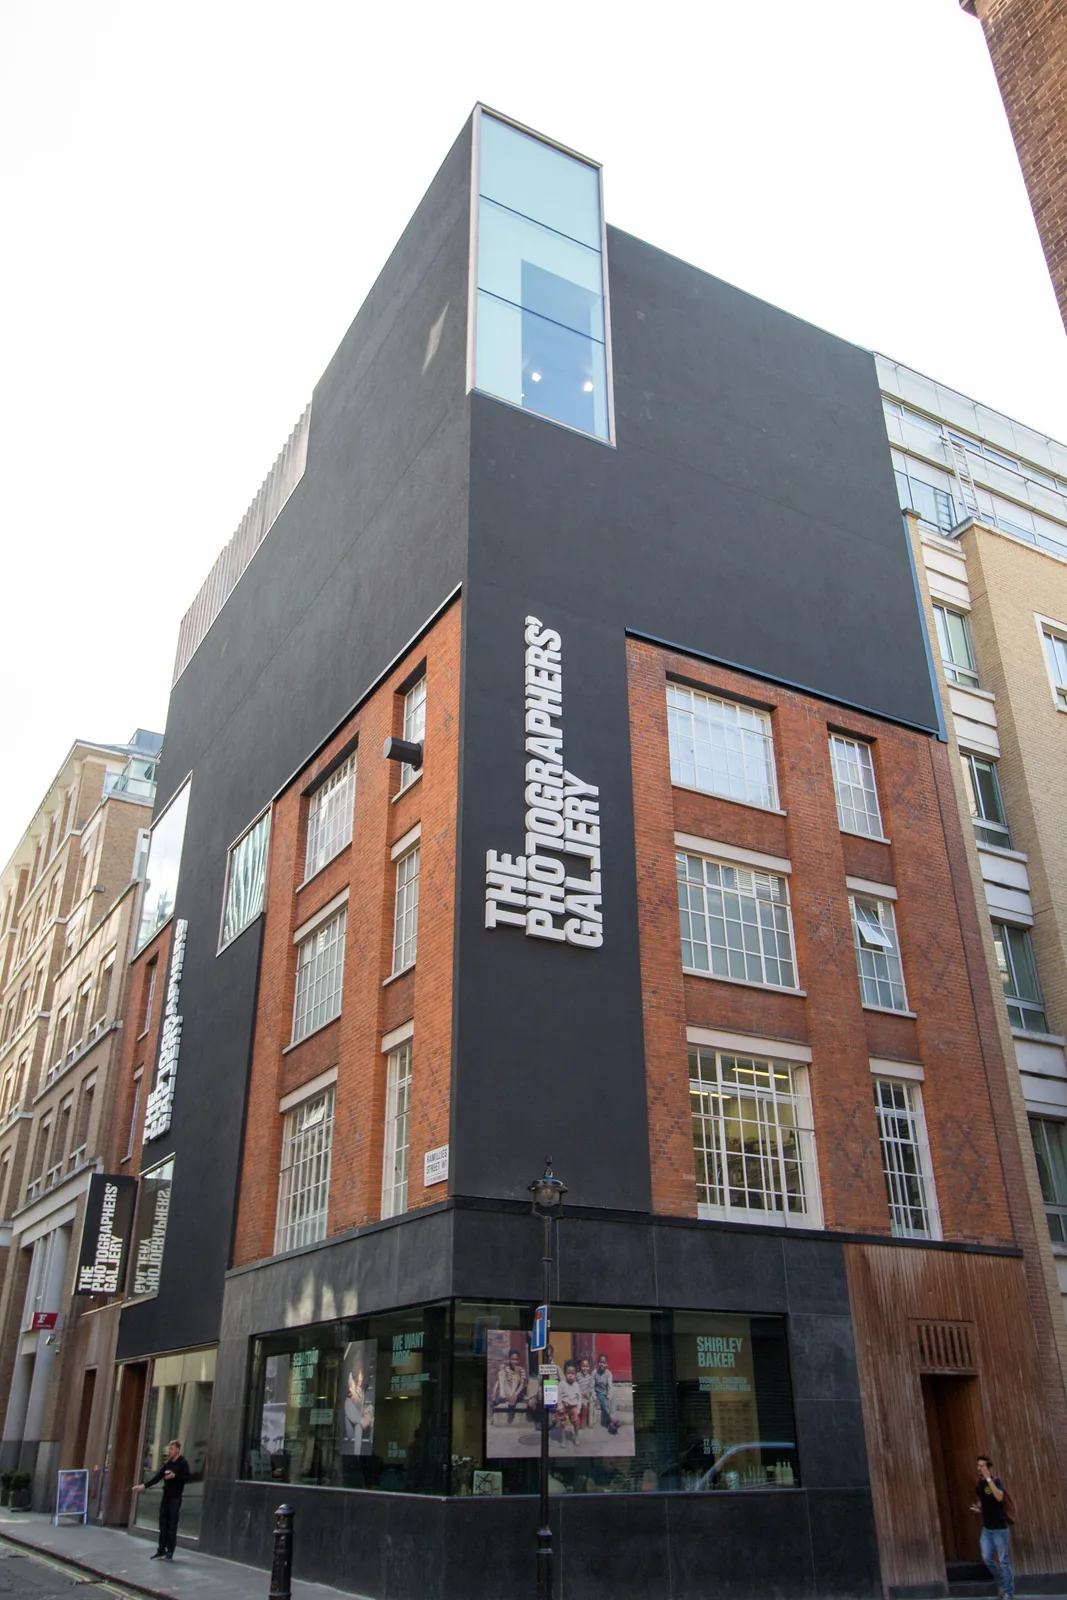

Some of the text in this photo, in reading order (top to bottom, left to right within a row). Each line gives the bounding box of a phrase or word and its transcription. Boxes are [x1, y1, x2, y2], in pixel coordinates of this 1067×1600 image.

[525, 615, 566, 942] PHOTOGRAPHERS'
[563, 769, 604, 949] GALLERY
[485, 849, 527, 929] THE
[78, 1265, 95, 1291] THE
[103, 1234, 123, 1293] GALLERY
[392, 1331, 425, 1351] WE WANT
[696, 1336, 744, 1353] SHIRLEY
[698, 1352, 735, 1369] BAKER
